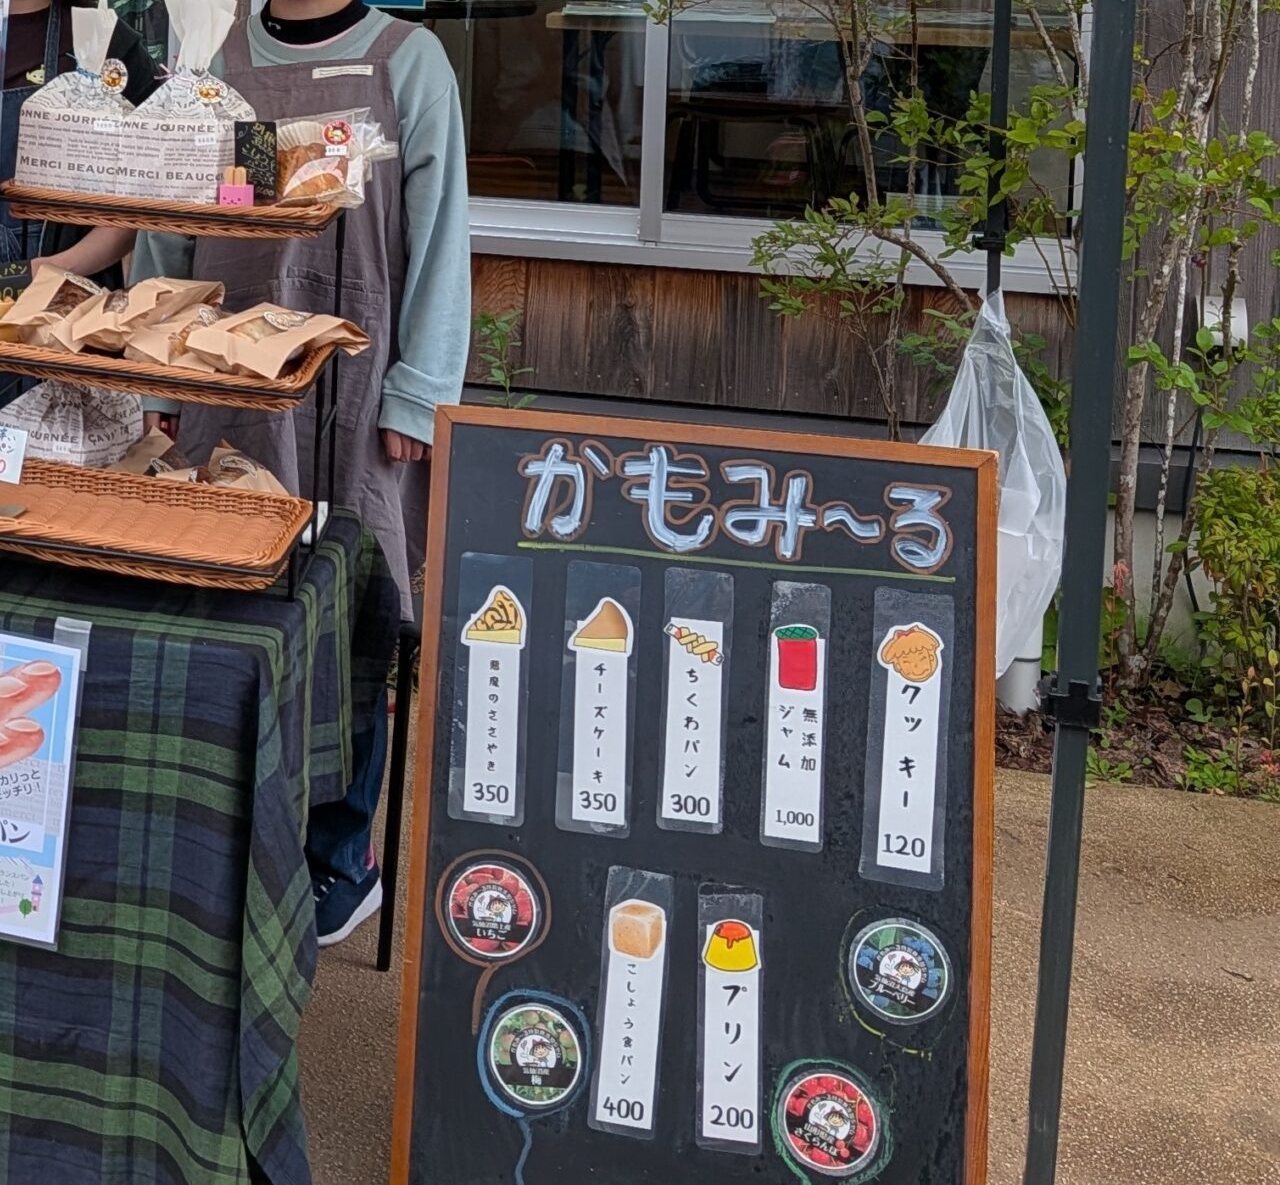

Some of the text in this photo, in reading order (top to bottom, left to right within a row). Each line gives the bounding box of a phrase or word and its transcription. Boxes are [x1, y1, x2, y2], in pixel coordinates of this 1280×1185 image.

[153, 122, 216, 133] JOURNÉE
[20, 156, 119, 175] MERCI BEAUC
[117, 166, 160, 180] MERCI
[520, 439, 952, 573] かもみ〜る
[487, 659, 500, 772] 悪魔のささやき
[592, 662, 608, 783] チーズケーキ
[683, 668, 700, 778] ちくわパン
[777, 704, 795, 769] ジャム
[800, 707, 818, 772] 無添加
[898, 684, 923, 808] クッキー
[472, 782, 509, 804] 350
[579, 790, 617, 812] 350
[670, 793, 711, 817] 300
[775, 809, 814, 827] 1,000
[881, 832, 926, 858] 120
[476, 927, 508, 940] いちご
[868, 979, 916, 1005] ブルーベリー
[722, 984, 748, 1083] プリン
[602, 1096, 645, 1121] 400
[709, 1105, 754, 1130] 200
[794, 1127, 838, 1156] さくらんぼ
